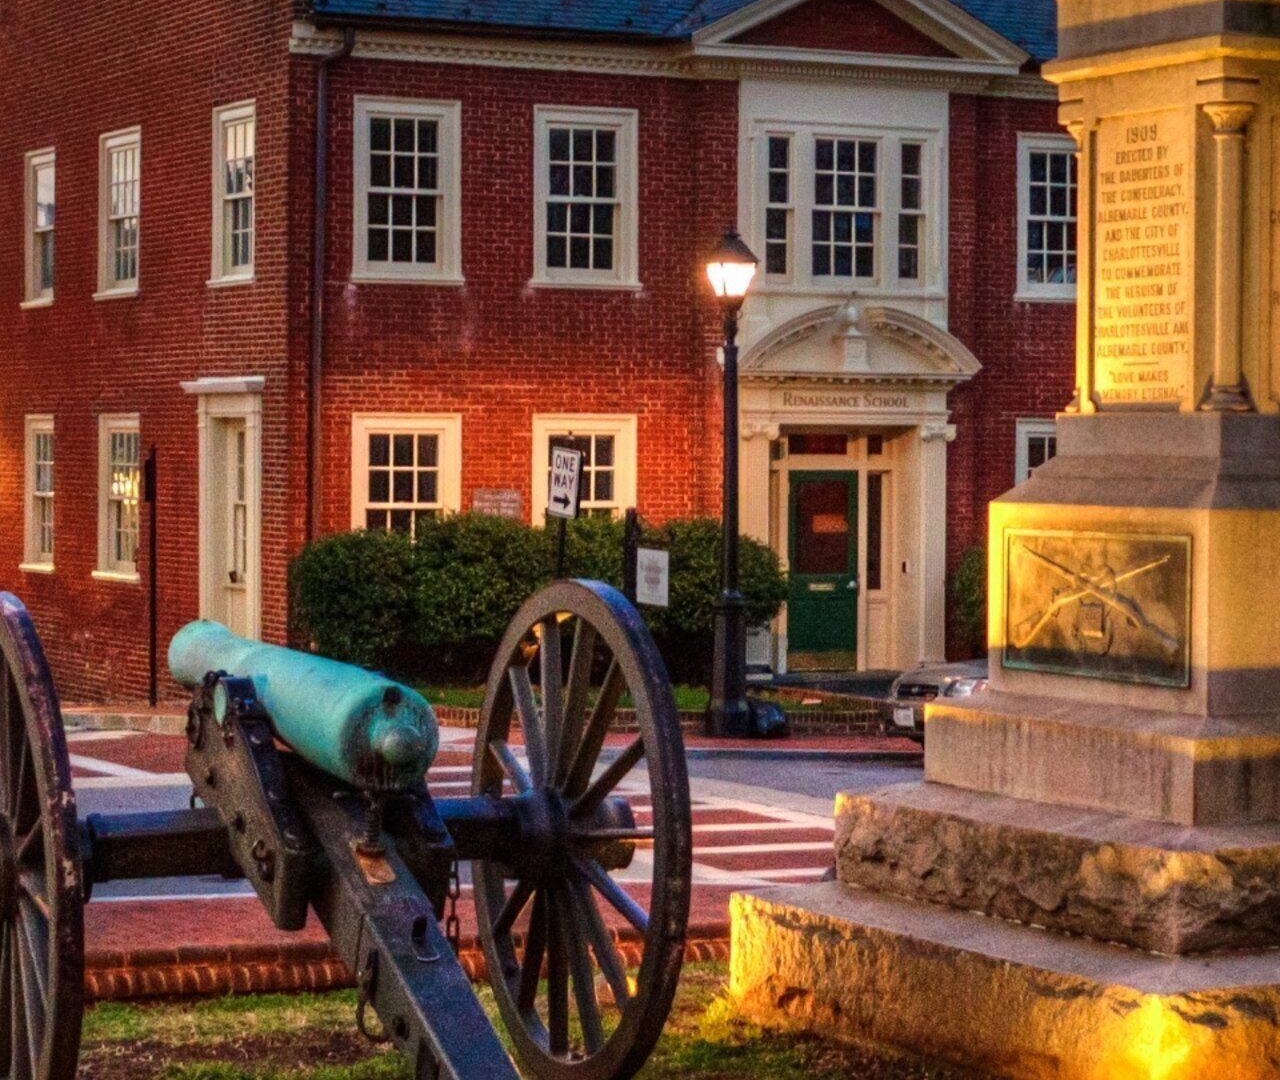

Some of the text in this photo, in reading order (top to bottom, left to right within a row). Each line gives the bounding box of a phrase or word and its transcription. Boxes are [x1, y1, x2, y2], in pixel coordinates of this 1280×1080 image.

[1126, 125, 1158, 144] 1909
[1115, 146, 1169, 165] ERECTED BY
[1100, 164, 1184, 185] THE DAUGHTERS OF
[1101, 192, 1116, 204] THE
[1098, 208, 1148, 223] ALBEMARLE
[1105, 224, 1179, 242] AND THE CITY OF
[1103, 243, 1181, 261] CHARLOTTESVILLE
[1101, 263, 1181, 281] TO COMMEMORATE
[1106, 282, 1178, 300] THE HEROISM OF
[1098, 302, 1186, 320] THE VOLUNTEERS OF
[1097, 344, 1147, 358] ALBEMARLE
[1138, 371, 1169, 383] MAKES
[556, 454, 575, 472] ONE
[554, 474, 574, 489] WAY
